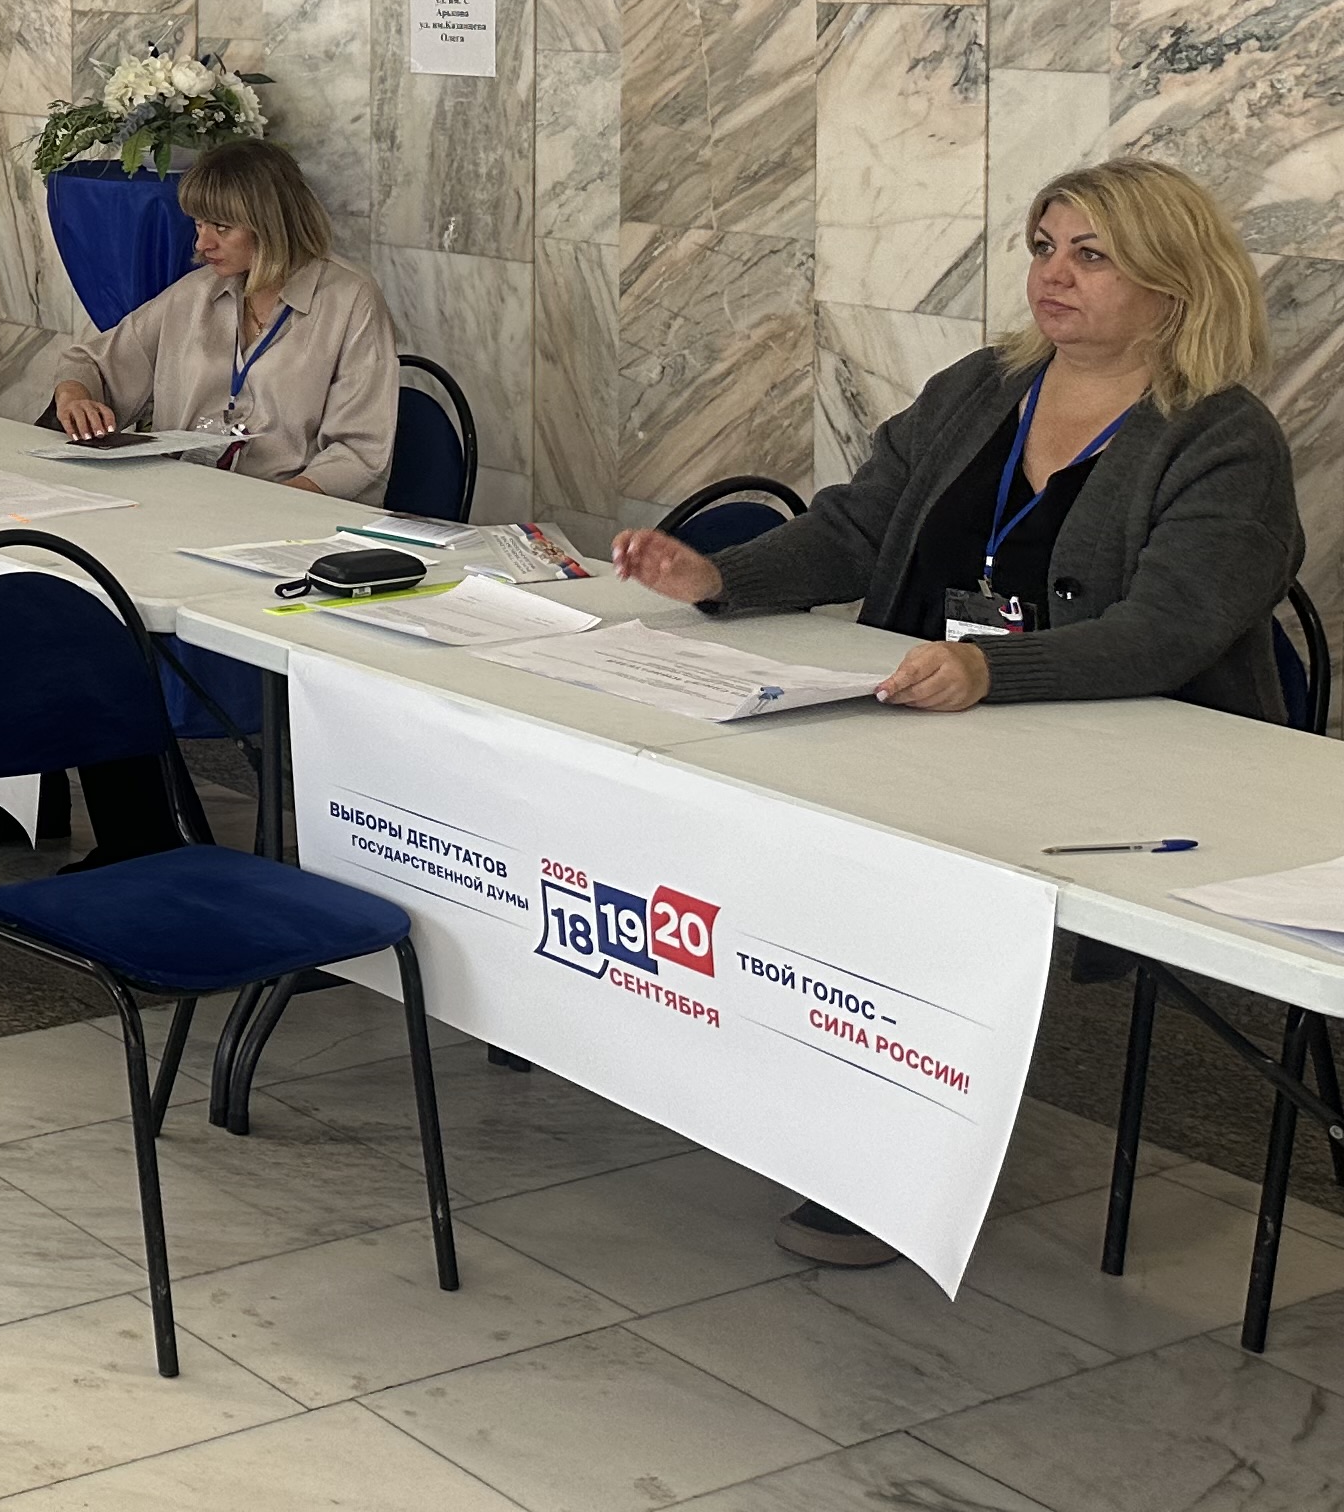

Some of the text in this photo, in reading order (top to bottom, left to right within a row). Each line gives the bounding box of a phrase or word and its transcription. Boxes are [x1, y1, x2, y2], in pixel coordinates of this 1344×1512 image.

[329, 801, 508, 878] ВЫБОРЫ ДЕПУТАТОВ
[351, 834, 530, 910] ГОСУДАРСТВЕННОЙ ДУМЫ
[541, 858, 588, 889] 2026
[551, 901, 710, 957] 18 19 20
[609, 967, 720, 1028] СЕНТЯБРЯ
[736, 951, 796, 989] ТВОЙ
[801, 975, 875, 1020] ГОЛОС
[809, 1008, 970, 1095] СИЛА РОССИИ!
